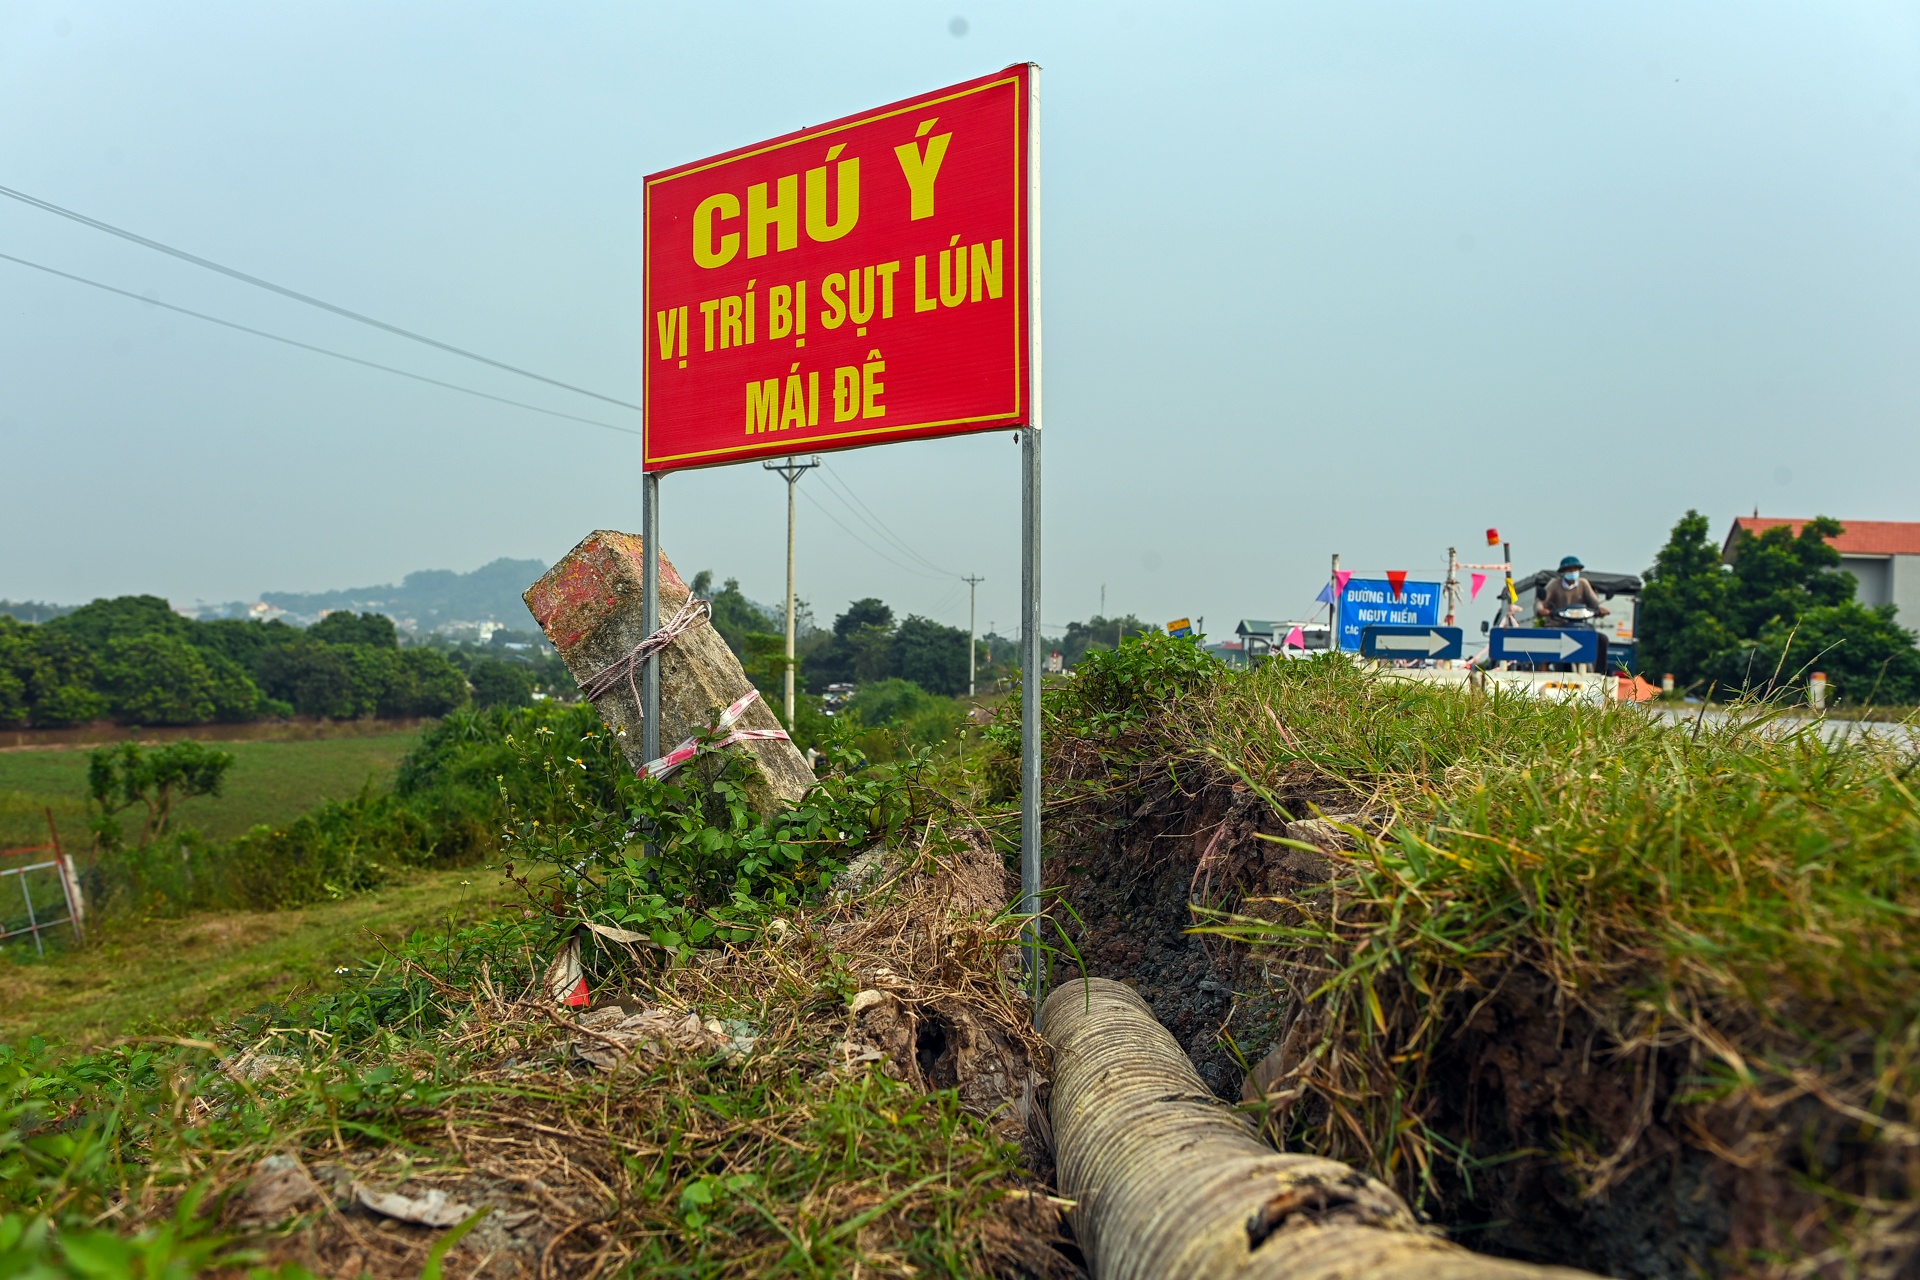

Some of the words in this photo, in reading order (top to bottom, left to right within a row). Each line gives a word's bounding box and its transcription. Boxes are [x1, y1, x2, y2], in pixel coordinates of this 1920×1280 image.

[692, 142, 860, 270] CHÚ
[893, 117, 954, 221] Ý
[656, 305, 688, 370] VỊ
[699, 279, 756, 353] TRÍ
[768, 280, 807, 348] BỊ
[820, 260, 900, 337] SỤT
[914, 233, 1004, 313] LÚN
[744, 362, 820, 435] MÁI
[831, 348, 887, 424] ĐÊ
[1358, 609, 1387, 622] NGUY
[1410, 593, 1431, 608] SỤT
[1345, 624, 1359, 635] CÁC
